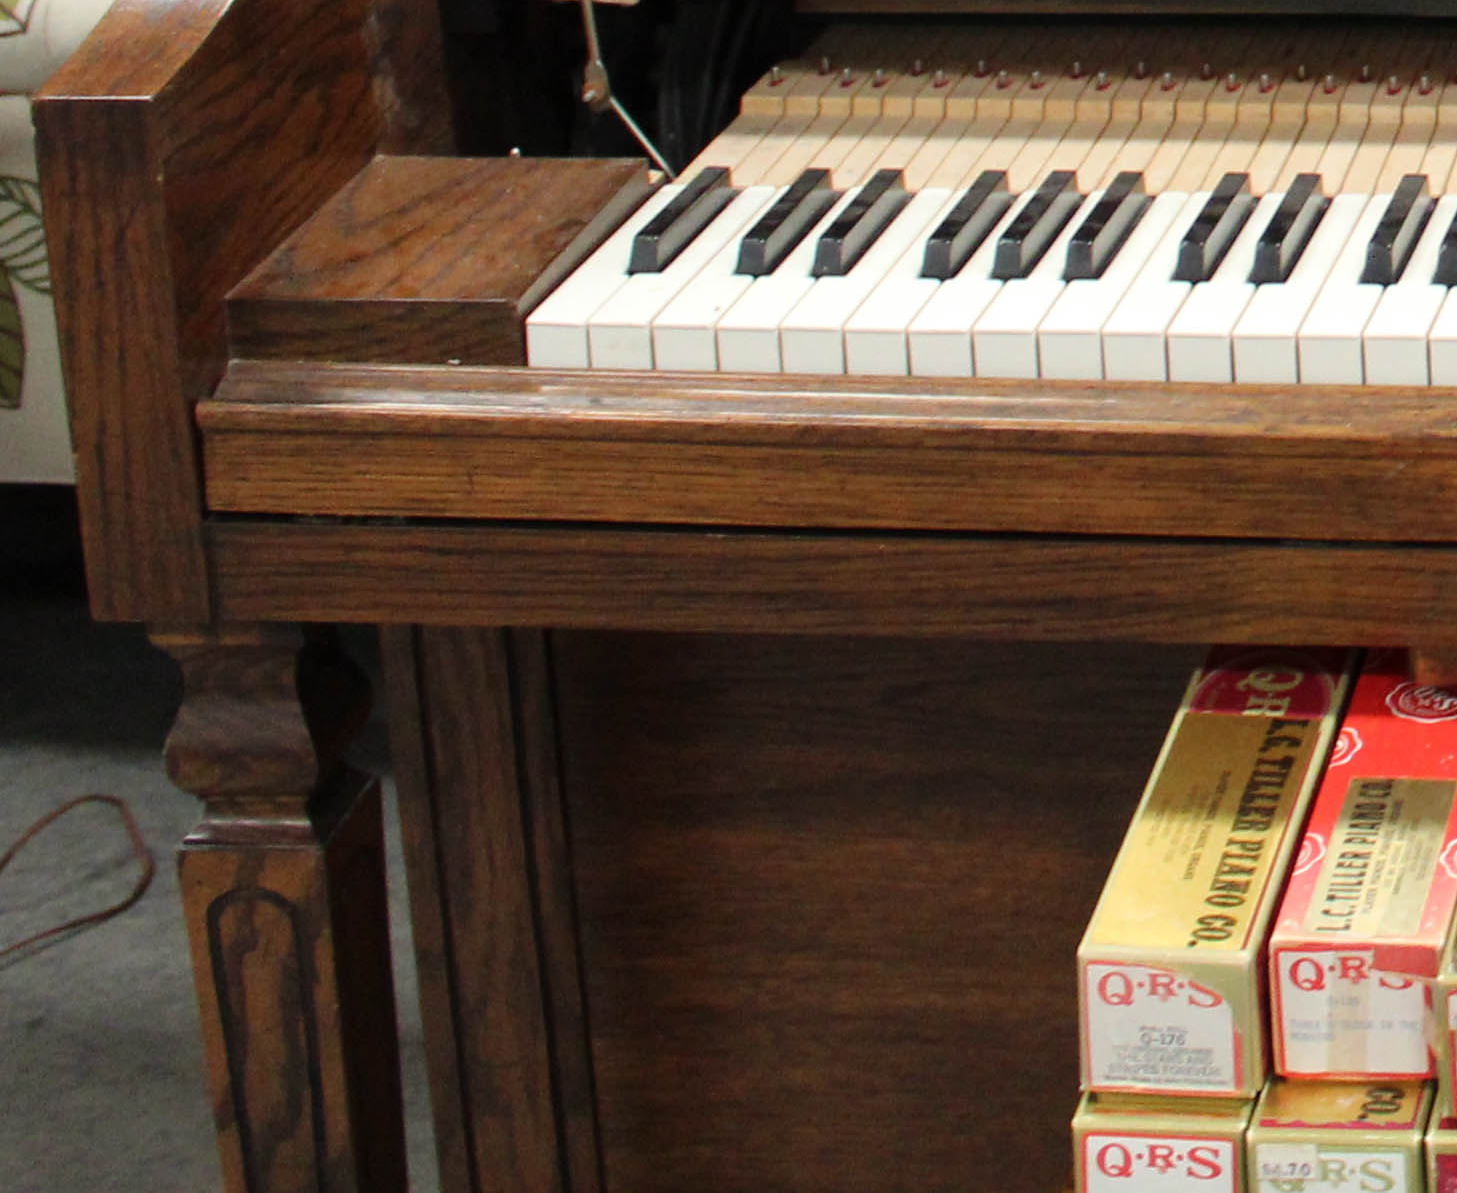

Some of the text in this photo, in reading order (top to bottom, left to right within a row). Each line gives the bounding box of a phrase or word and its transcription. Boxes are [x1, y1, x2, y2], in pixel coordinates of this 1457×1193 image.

[1229, 755, 1296, 833] TILLER
[1359, 778, 1396, 800] CO.
[1343, 801, 1388, 846] PIANO
[1203, 837, 1266, 908] PIANO
[1325, 850, 1370, 903] TILLER
[1186, 912, 1238, 949] CO.
